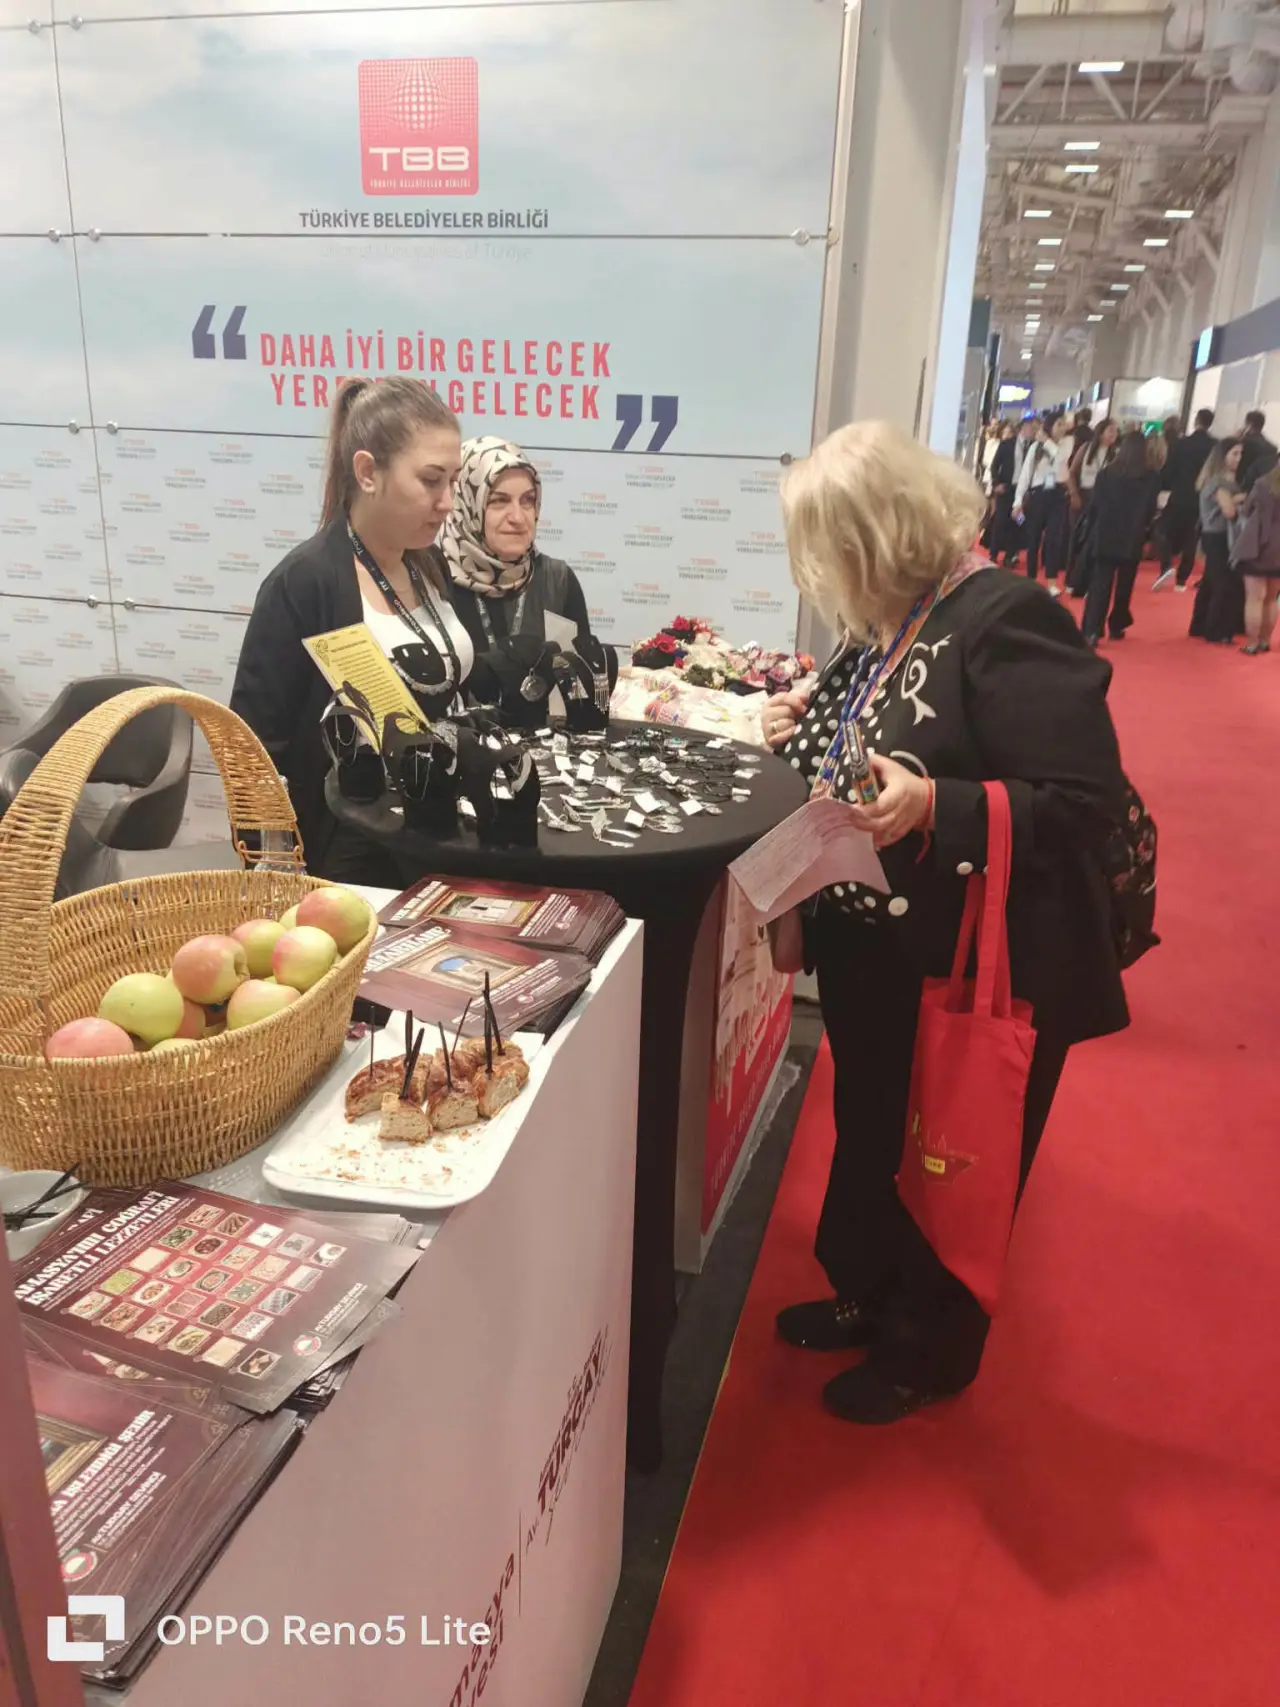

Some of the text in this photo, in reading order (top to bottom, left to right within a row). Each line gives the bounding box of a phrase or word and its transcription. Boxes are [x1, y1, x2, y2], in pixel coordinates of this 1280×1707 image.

[368, 146, 469, 172] TBB
[299, 209, 548, 228] TÜRKİYE BELEDİYELER BİRLİĞİ
[260, 328, 611, 378] DAHA İYİ BİR GELECEK
[449, 379, 600, 420] GELECEK
[537, 1339, 602, 1516] TURGAY
